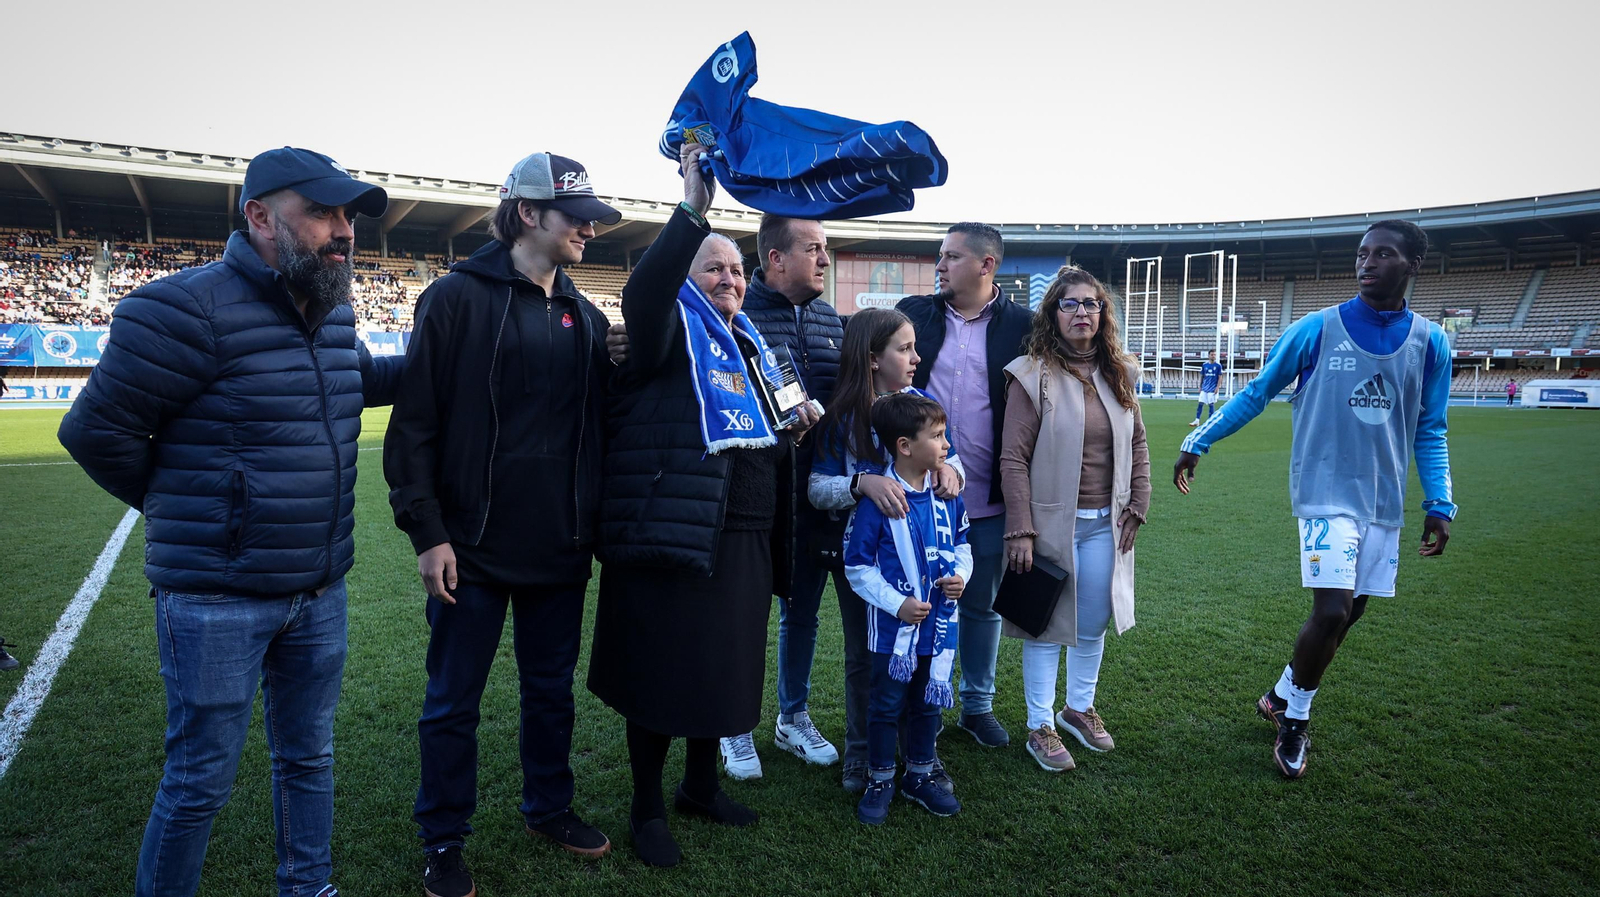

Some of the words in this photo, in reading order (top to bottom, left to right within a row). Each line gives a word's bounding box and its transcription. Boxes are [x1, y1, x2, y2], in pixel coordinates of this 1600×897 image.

[856, 252, 890, 260] BIENVENIDOS
[860, 295, 901, 307] Cruzcam
[1328, 356, 1357, 371] 22
[1348, 395, 1391, 410] adidas
[1303, 518, 1331, 551] 22
